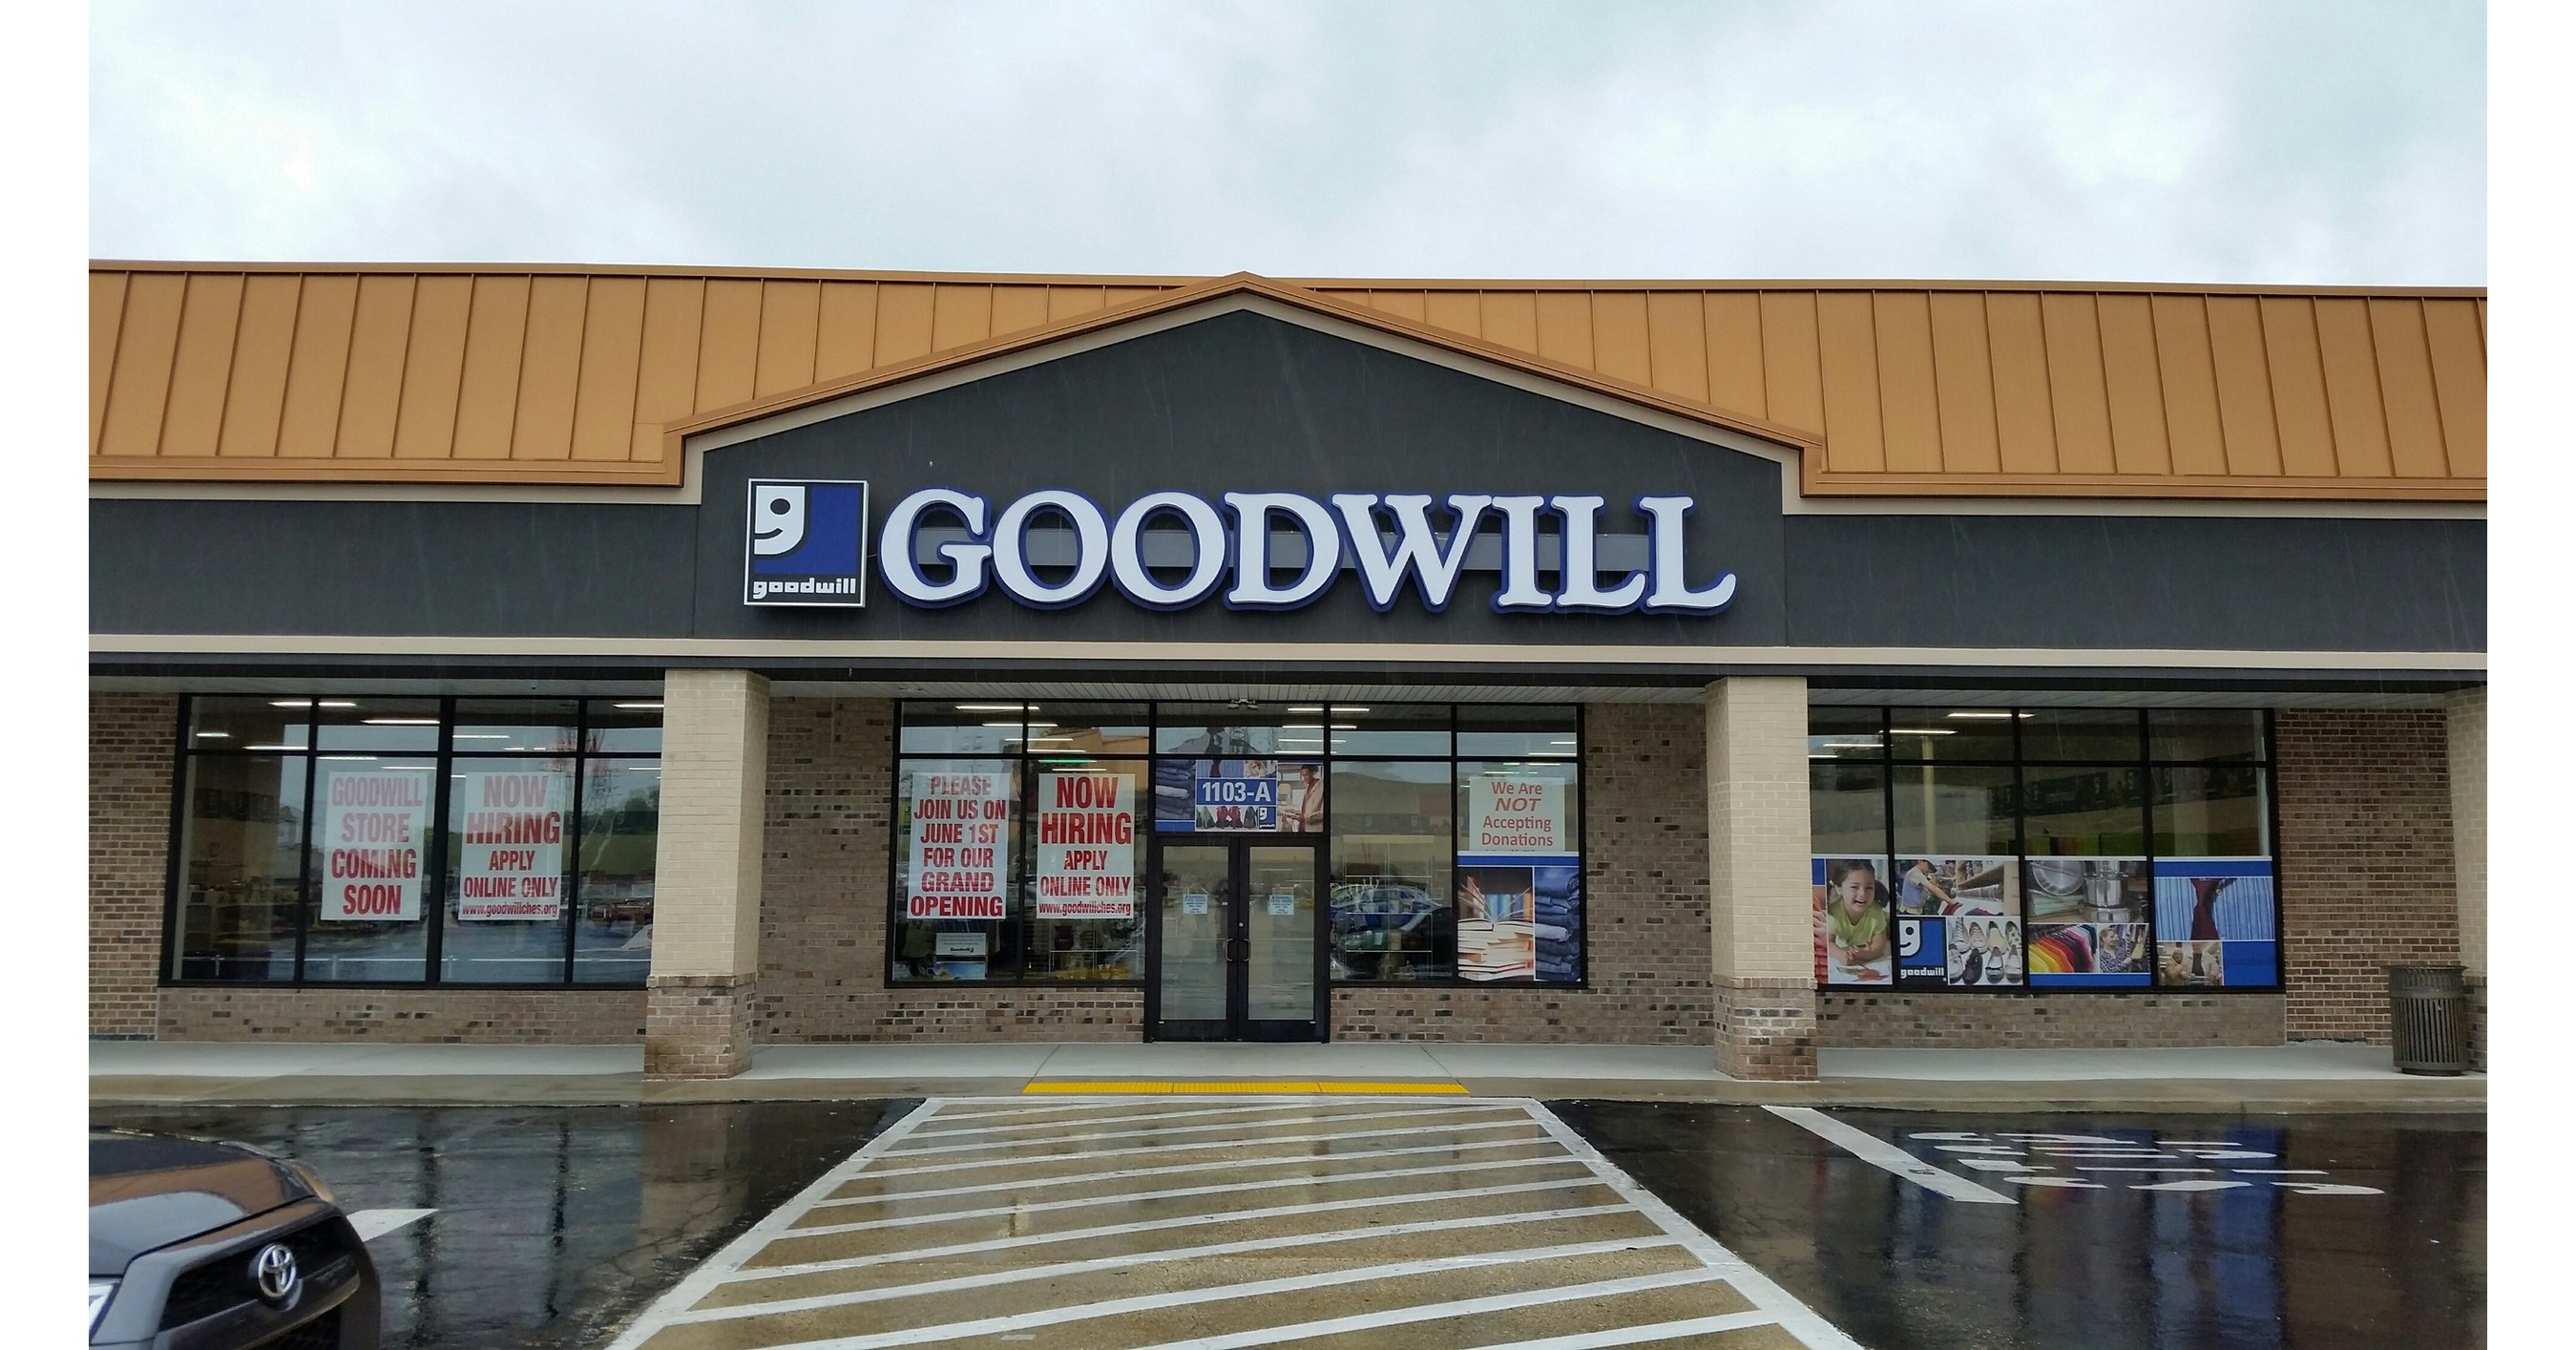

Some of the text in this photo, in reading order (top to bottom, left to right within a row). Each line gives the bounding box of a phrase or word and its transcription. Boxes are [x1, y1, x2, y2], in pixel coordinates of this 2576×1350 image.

[876, 485, 1739, 616] GOODWILL
[752, 577, 856, 600] goodwill
[332, 776, 423, 807] GOODWILL
[483, 775, 548, 808] NOW
[930, 775, 992, 795] PLEASE
[1056, 776, 1119, 809] NOW
[1202, 781, 1271, 802] 1103-A
[1491, 781, 1543, 795] We Are
[913, 798, 1006, 820] JOIN US ON
[1495, 797, 1542, 812] NOT
[341, 812, 410, 843] STORE
[466, 811, 561, 845] HIRING
[920, 823, 999, 844] JUNE 1ST
[1041, 812, 1132, 845] HIRING
[1482, 814, 1552, 833] Accepting
[1481, 832, 1554, 847] Donations
[331, 848, 418, 879] COMING
[489, 850, 535, 871] APPLY
[923, 847, 995, 868] FOR OUR
[1063, 850, 1108, 871] APPLY
[463, 876, 558, 898] ONLINE ONLY
[920, 871, 995, 893] GRAND
[1039, 875, 1131, 896] ONLINE ONLY
[343, 884, 402, 916] SOON
[910, 895, 1003, 918] OPENING
[1900, 966, 1944, 980] goodwill
